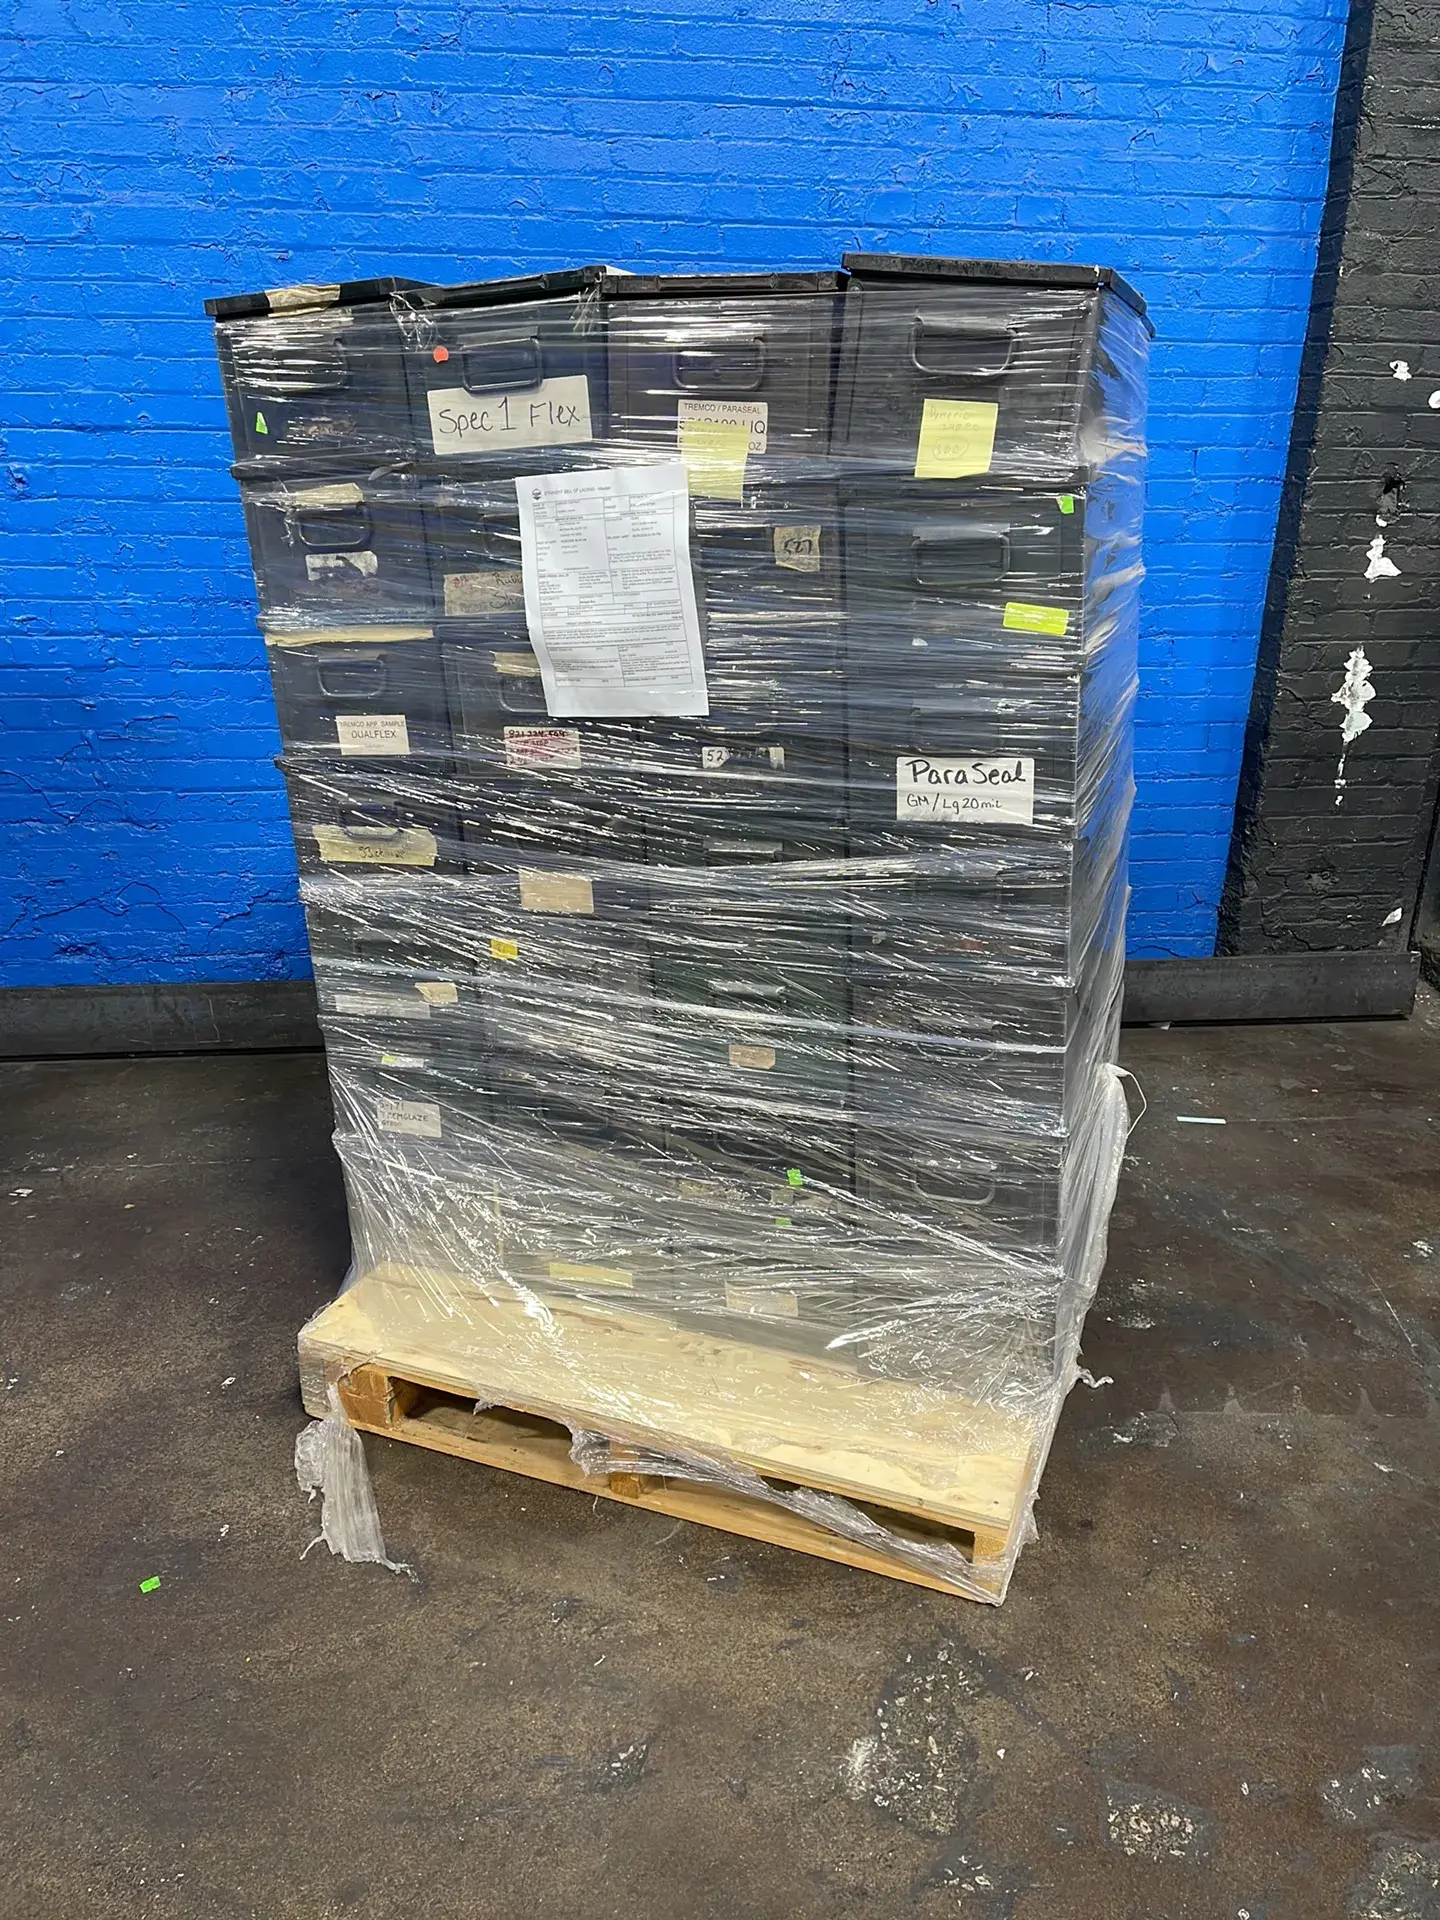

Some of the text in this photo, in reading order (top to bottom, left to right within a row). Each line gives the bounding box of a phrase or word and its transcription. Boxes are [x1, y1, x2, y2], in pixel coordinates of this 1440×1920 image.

[684, 402, 716, 412] TREMCO
[722, 404, 761, 414] PARASEAL
[439, 396, 580, 438] Spec 1 Flex
[339, 720, 364, 728] TREMCO
[351, 730, 397, 739] DUALFLEX
[706, 749, 724, 762] 52
